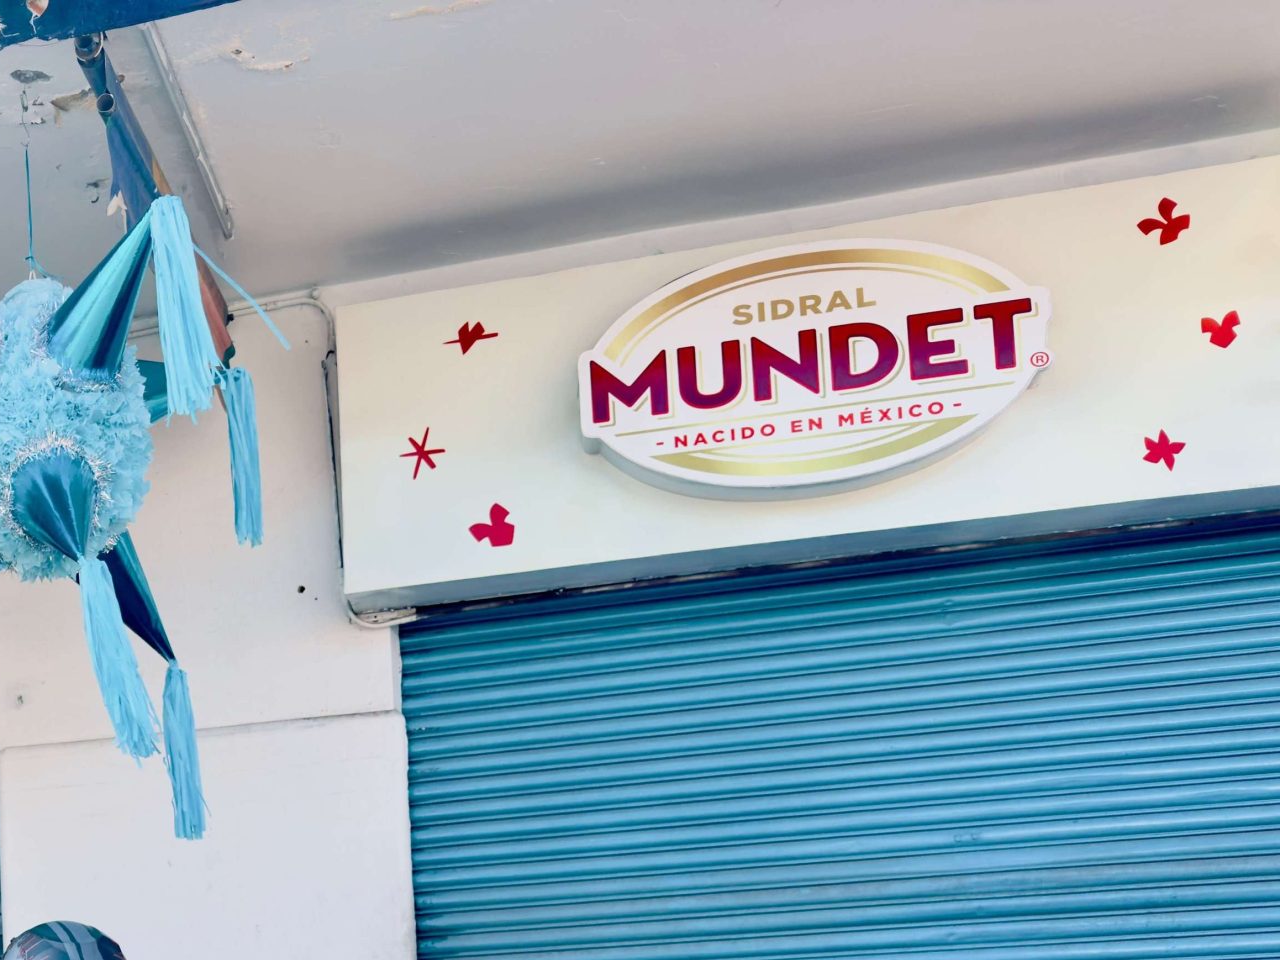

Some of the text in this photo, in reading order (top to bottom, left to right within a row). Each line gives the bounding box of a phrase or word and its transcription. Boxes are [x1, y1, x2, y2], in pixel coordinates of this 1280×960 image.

[732, 286, 878, 326] SIDRAL
[589, 297, 1033, 424] MUNDET
[674, 401, 945, 449] NACIDO EN MÉXICO
